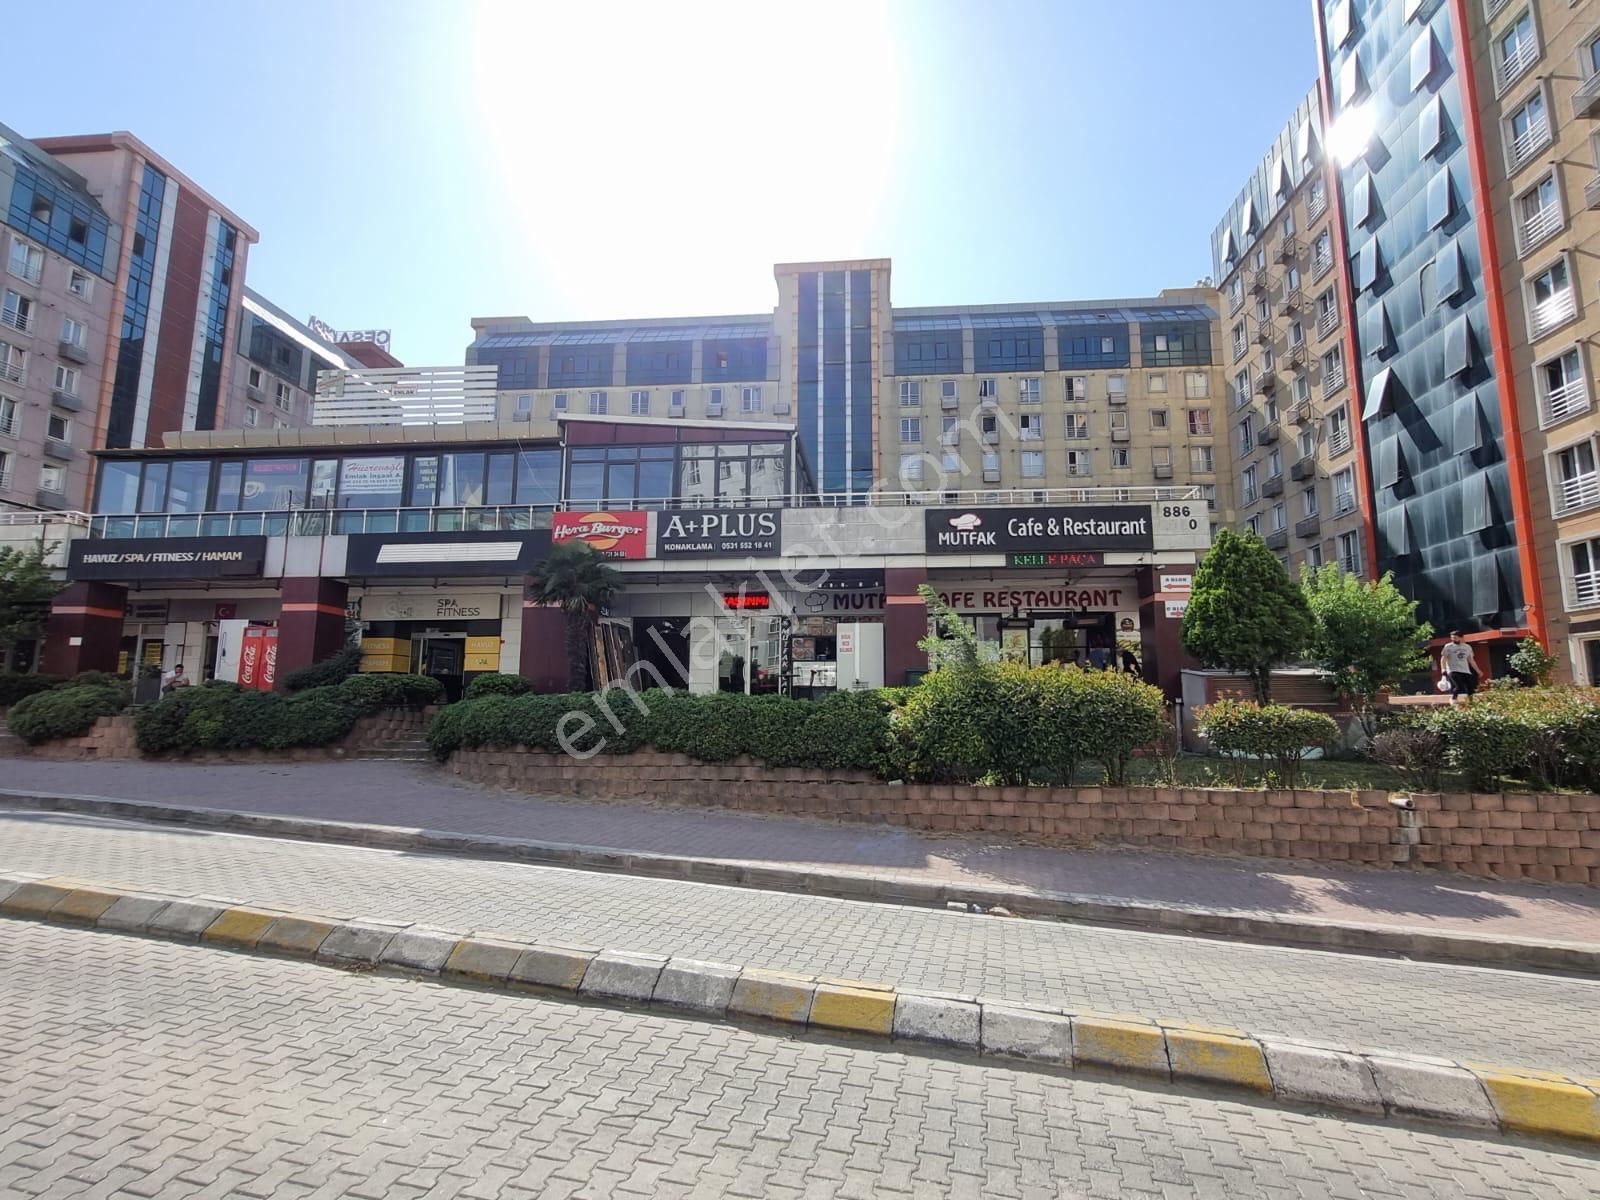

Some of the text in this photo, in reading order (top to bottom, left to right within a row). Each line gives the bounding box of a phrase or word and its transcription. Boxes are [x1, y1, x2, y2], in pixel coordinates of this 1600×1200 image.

[1163, 506, 1191, 518] 886
[590, 522, 643, 539] Burger
[661, 512, 776, 538] A+PLUS
[1008, 517, 1147, 537] Cafe & Restaurant
[938, 531, 996, 546] MUTFAK
[664, 543, 713, 551] KONAKLAMA
[83, 554, 118, 563] HAVUZ
[125, 554, 145, 562] SPA
[152, 553, 194, 562] FITNESS
[202, 552, 243, 560] HAMAM
[437, 599, 458, 607] SPA
[937, 592, 975, 608] AFE
[983, 590, 1122, 607] RESTAURANT
[436, 607, 480, 616] FITNESS
